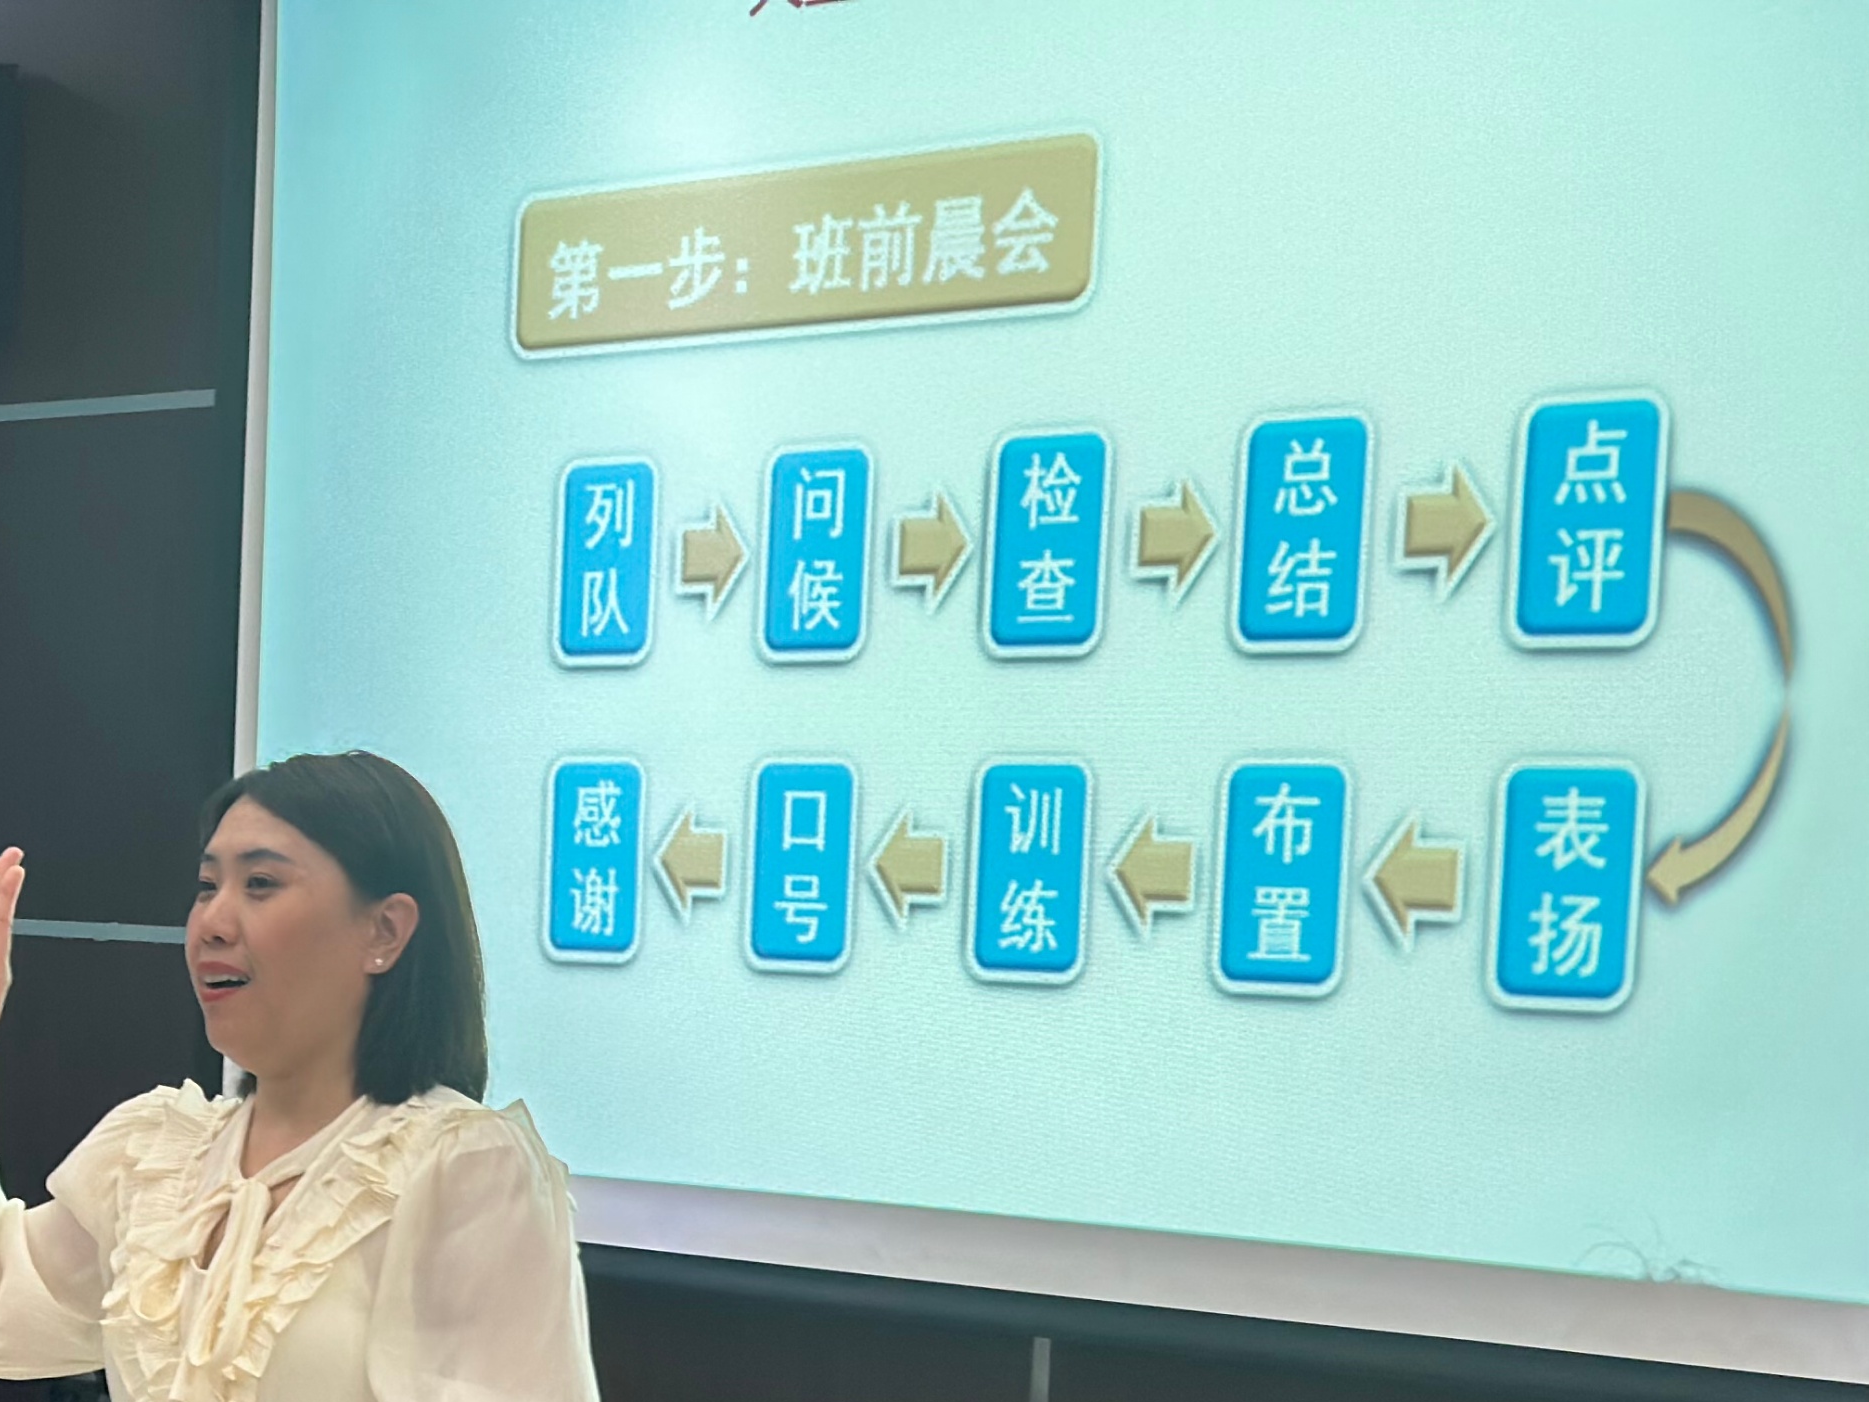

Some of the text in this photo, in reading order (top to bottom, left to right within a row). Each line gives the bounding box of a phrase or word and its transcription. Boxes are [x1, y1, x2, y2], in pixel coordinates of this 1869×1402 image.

[547, 187, 1058, 321] 第一步：班前晨会
[580, 478, 635, 638] 列队
[787, 467, 846, 633] 问候
[1016, 451, 1082, 625] 检查
[1264, 436, 1338, 619] 总结
[1548, 419, 1628, 613] 点评
[569, 779, 623, 938] 感谢
[774, 789, 828, 945] 口号
[998, 783, 1064, 954] 训练
[1246, 781, 1321, 963] 布置
[1529, 786, 1609, 978] 表扬
